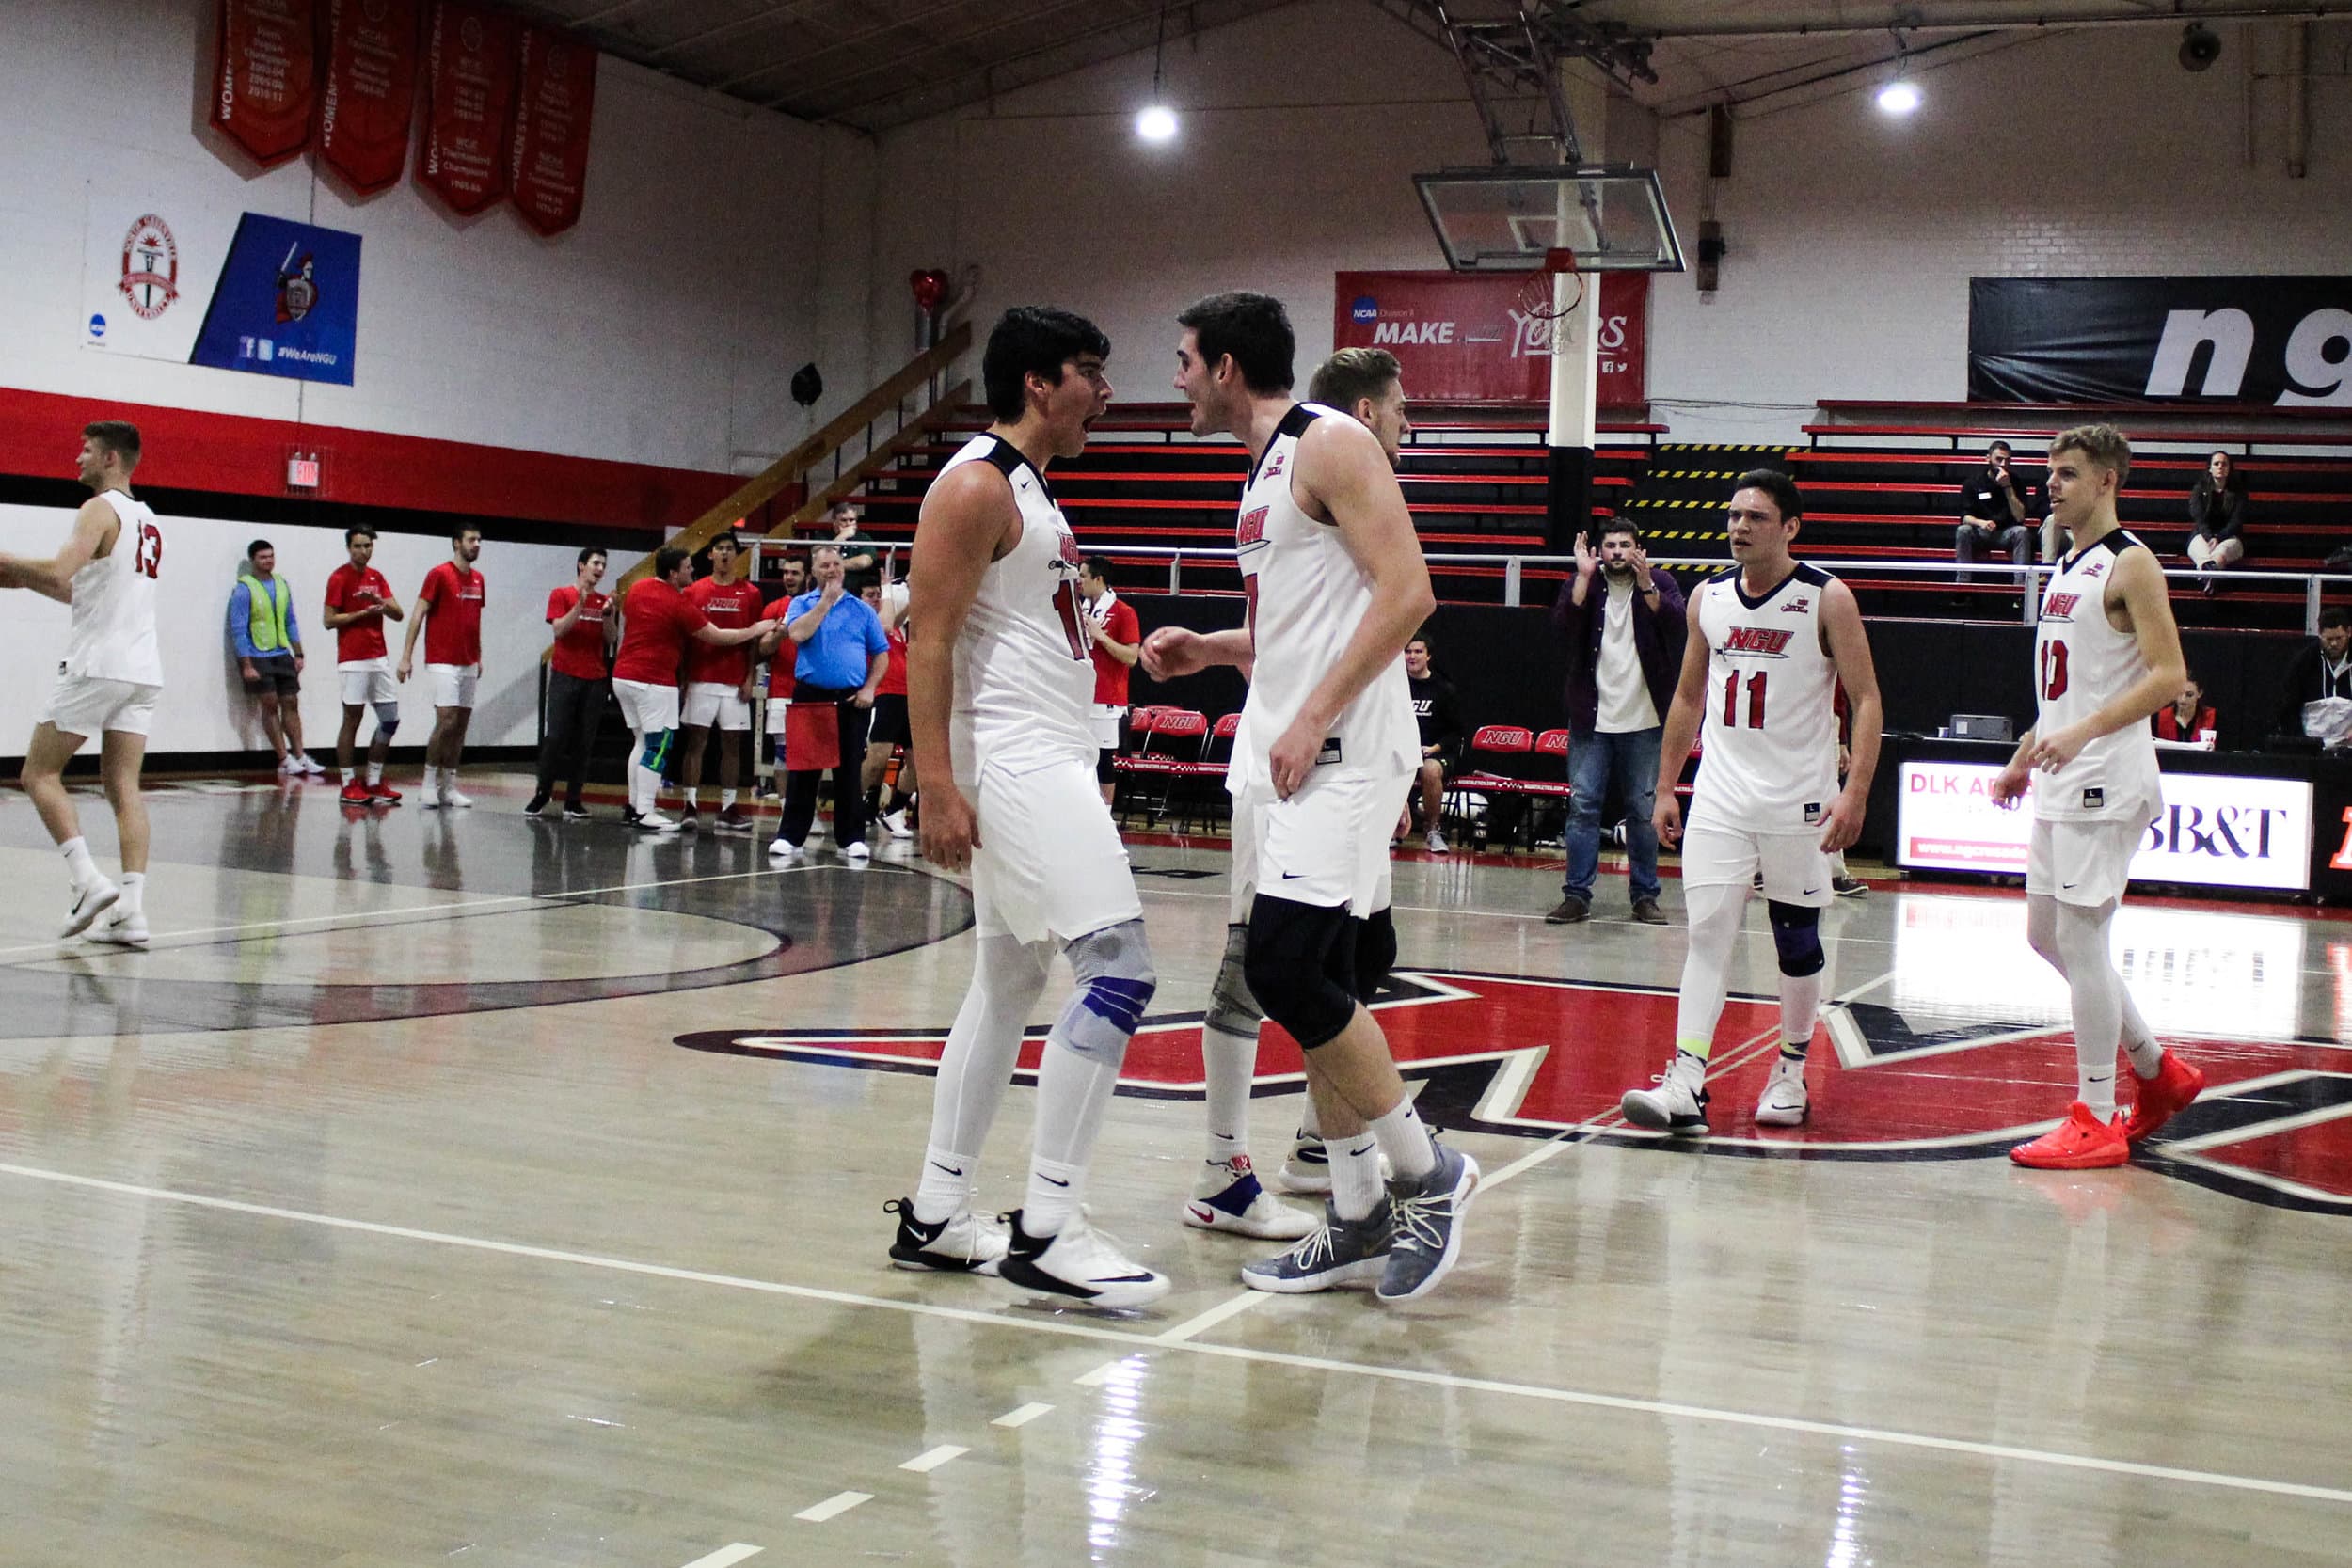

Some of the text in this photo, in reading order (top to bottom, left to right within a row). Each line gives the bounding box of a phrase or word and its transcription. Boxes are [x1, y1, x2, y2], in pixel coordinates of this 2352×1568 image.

[1353, 309, 1378, 319] NCAA
[1373, 322, 1455, 345] MAKE
[278, 346, 338, 366] #WeAreNGU
[135, 519, 162, 579] 13
[2043, 592, 2082, 616] NGU
[1725, 626, 1795, 654] NGU
[1411, 699, 1433, 712] GU
[1724, 669, 1768, 730] 11
[1159, 716, 1201, 729] NGU
[1481, 730, 1524, 745] NGU
[1910, 773, 1960, 795] DLK
